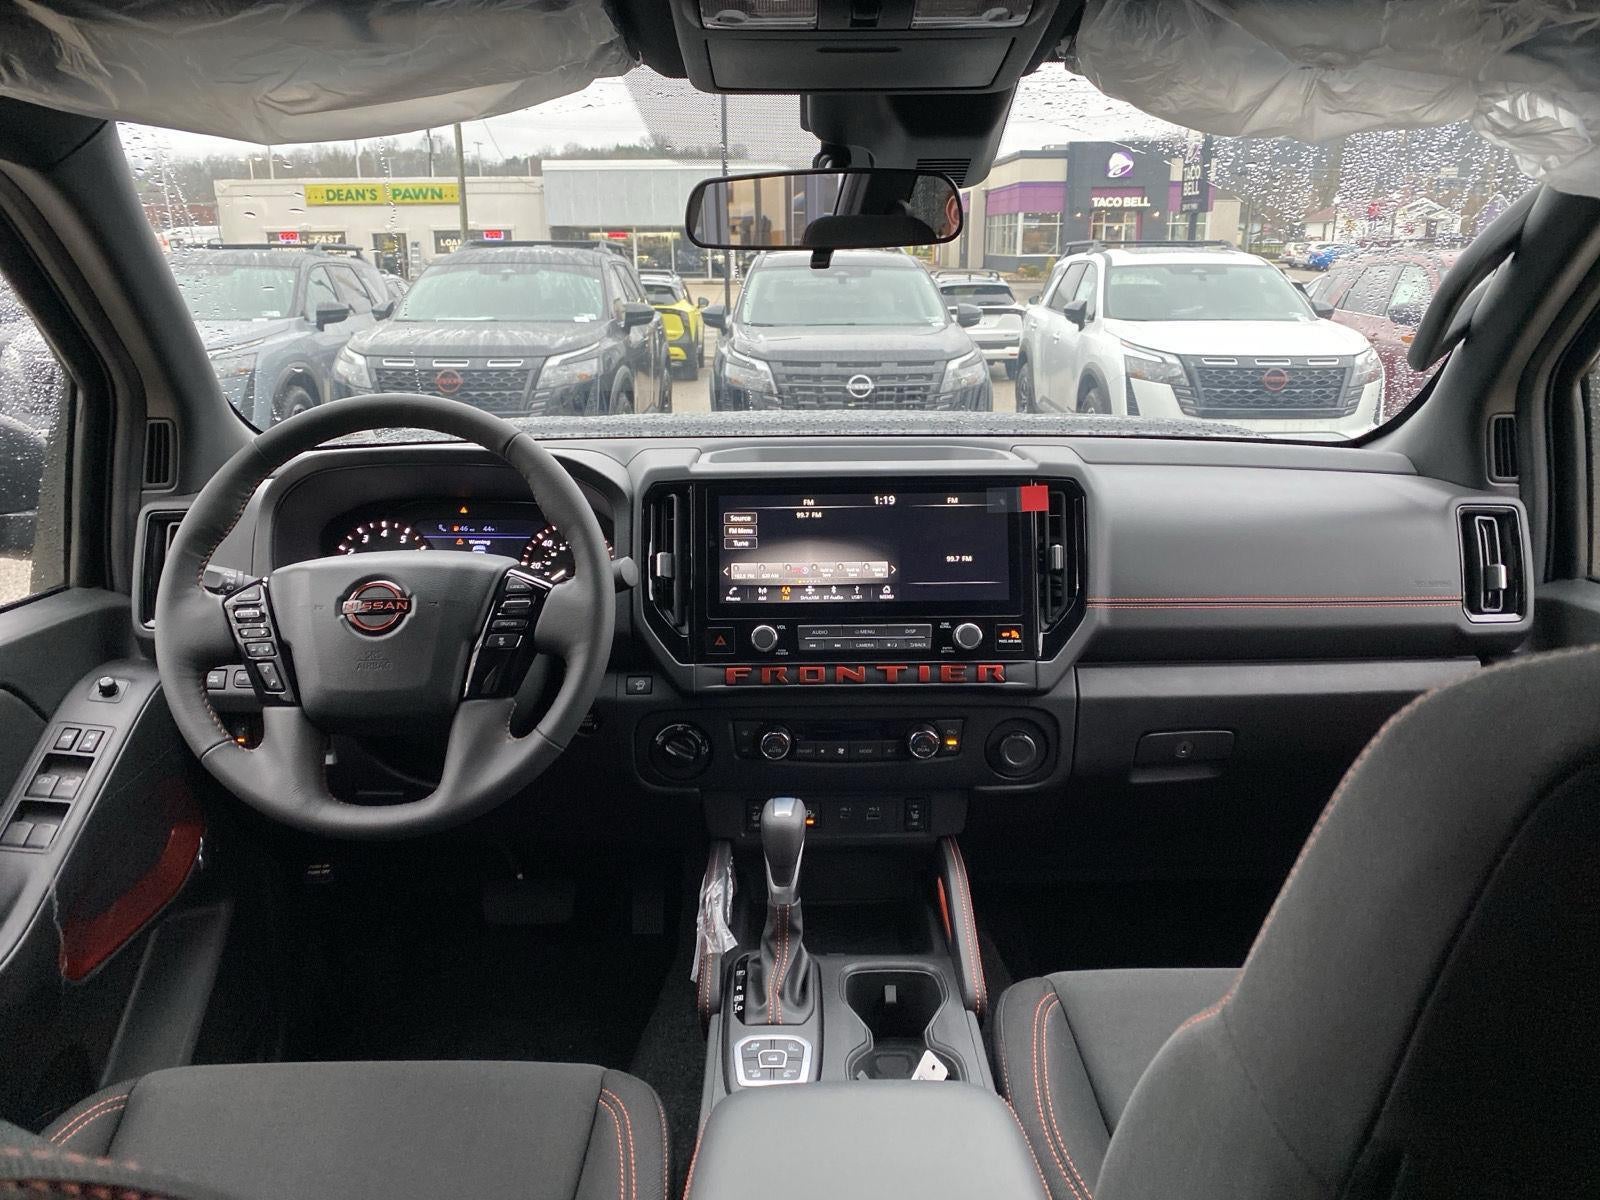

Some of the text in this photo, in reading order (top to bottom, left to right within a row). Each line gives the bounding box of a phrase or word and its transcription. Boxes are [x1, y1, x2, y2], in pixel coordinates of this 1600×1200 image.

[1183, 165, 1201, 181] TACO
[1183, 181, 1200, 196] BELL
[326, 187, 443, 201] DEAN'S PAWN
[1092, 196, 1151, 207] TACO BELL
[314, 234, 341, 243] FAST
[873, 495, 896, 505] 1:19
[730, 514, 752, 522] Source
[796, 511, 809, 519] 99.7
[380, 529, 388, 538] 4
[361, 534, 369, 544] 3
[399, 534, 407, 544] 5
[530, 562, 541, 570] 20
[344, 600, 408, 612] NISSAN
[725, 664, 1007, 685] FRONTIER
